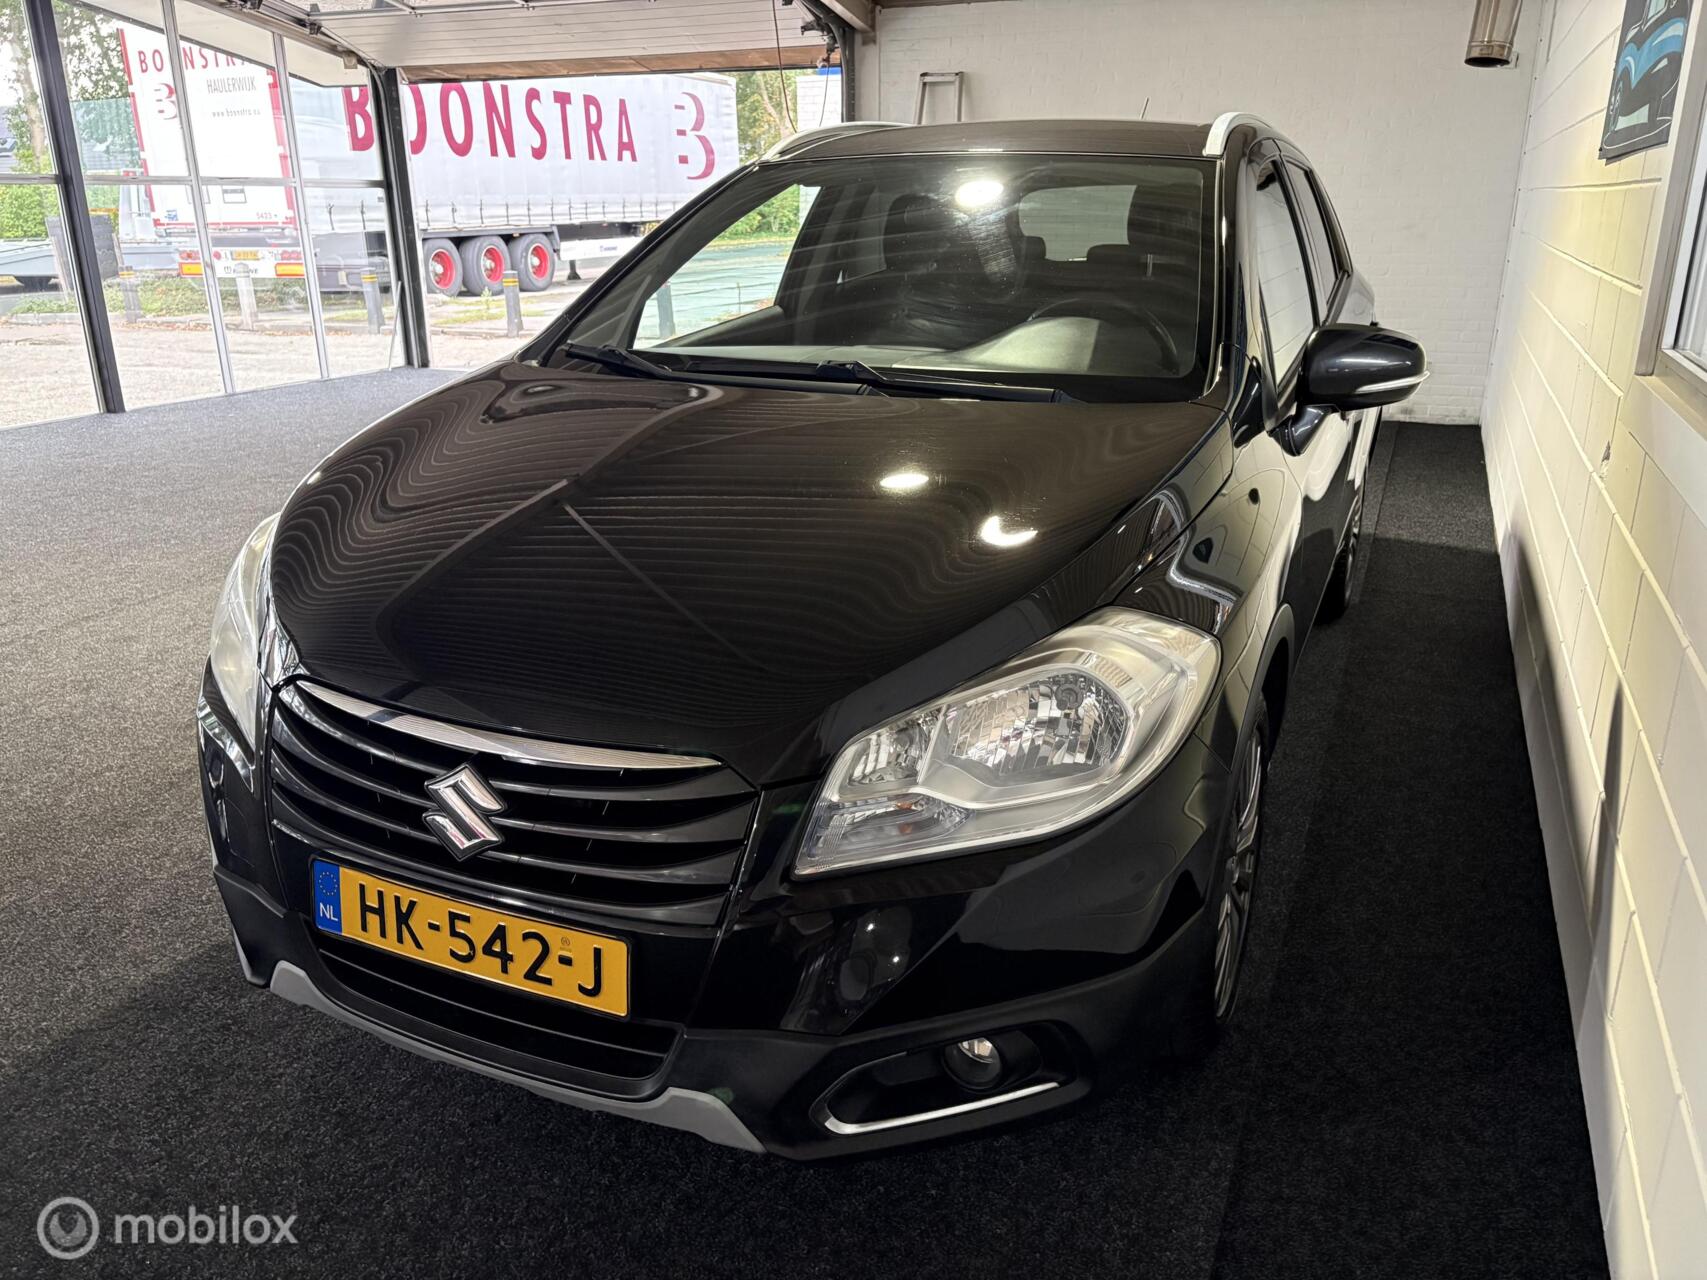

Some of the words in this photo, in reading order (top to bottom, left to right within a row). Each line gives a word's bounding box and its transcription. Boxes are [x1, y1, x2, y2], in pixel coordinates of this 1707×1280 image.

[138, 46, 245, 74] BONST
[206, 76, 257, 94] HAULERWIJK
[319, 901, 339, 922] NL
[358, 882, 602, 998] HK-542-J
